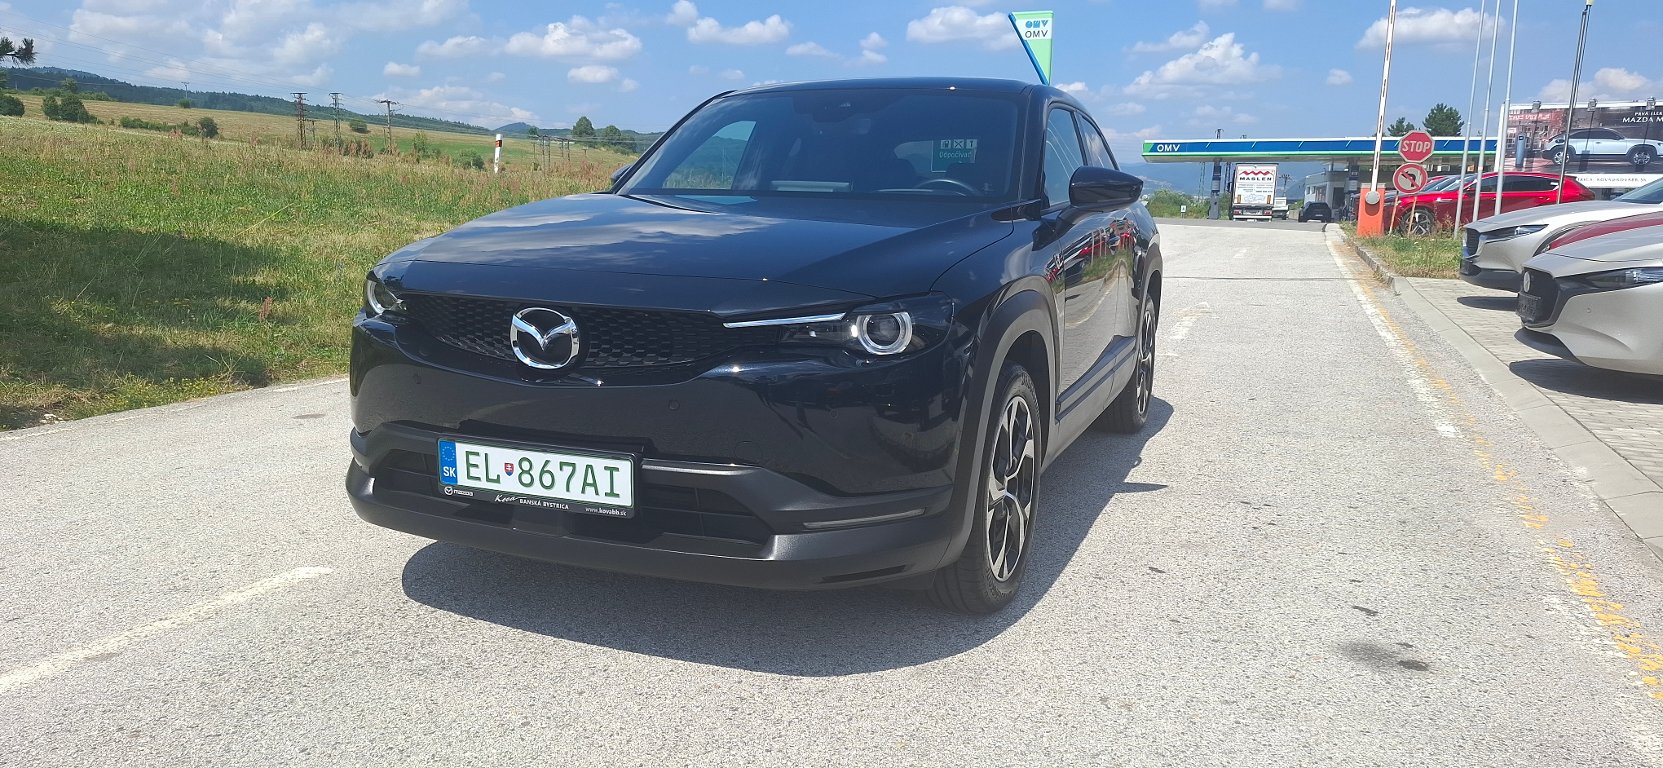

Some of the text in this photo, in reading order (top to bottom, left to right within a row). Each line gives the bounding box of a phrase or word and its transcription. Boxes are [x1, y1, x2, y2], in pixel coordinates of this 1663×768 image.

[1025, 30, 1048, 38] OMV
[1157, 144, 1180, 152] OMV
[1402, 141, 1430, 152] STOP
[443, 466, 456, 478] SK
[465, 451, 620, 498] EL 867AI
[543, 501, 569, 510] BYSTRICA
